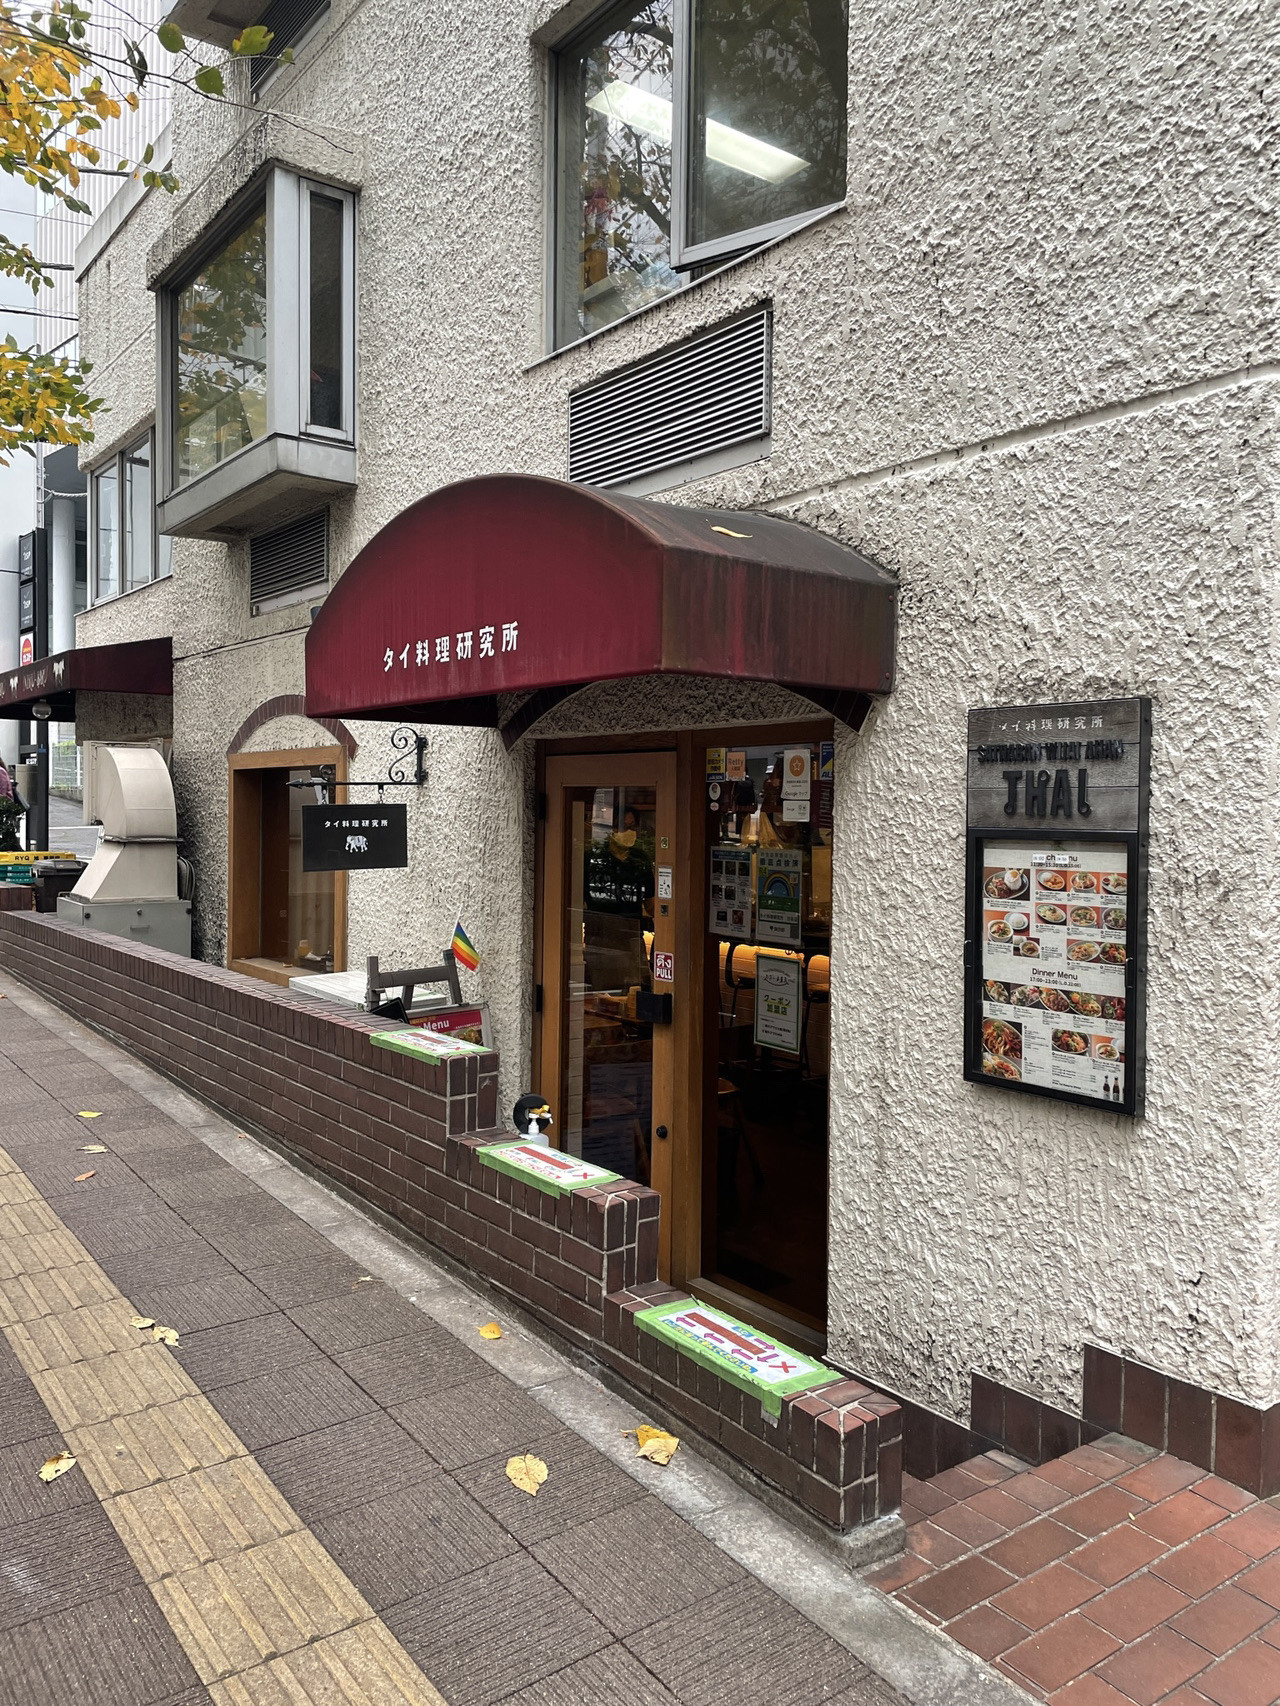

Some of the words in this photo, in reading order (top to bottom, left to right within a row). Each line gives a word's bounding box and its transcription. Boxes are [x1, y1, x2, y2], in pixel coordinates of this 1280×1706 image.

[383, 620, 519, 673] タイ料理研究所
[999, 715, 1103, 731] タイ料理研究所
[1003, 768, 1091, 817] THAI
[324, 819, 388, 828] タイ料理研究所
[656, 967, 672, 980] PULL
[1032, 967, 1056, 978] Dinner
[1057, 971, 1078, 981] Menu
[423, 1020, 450, 1031] Menu
